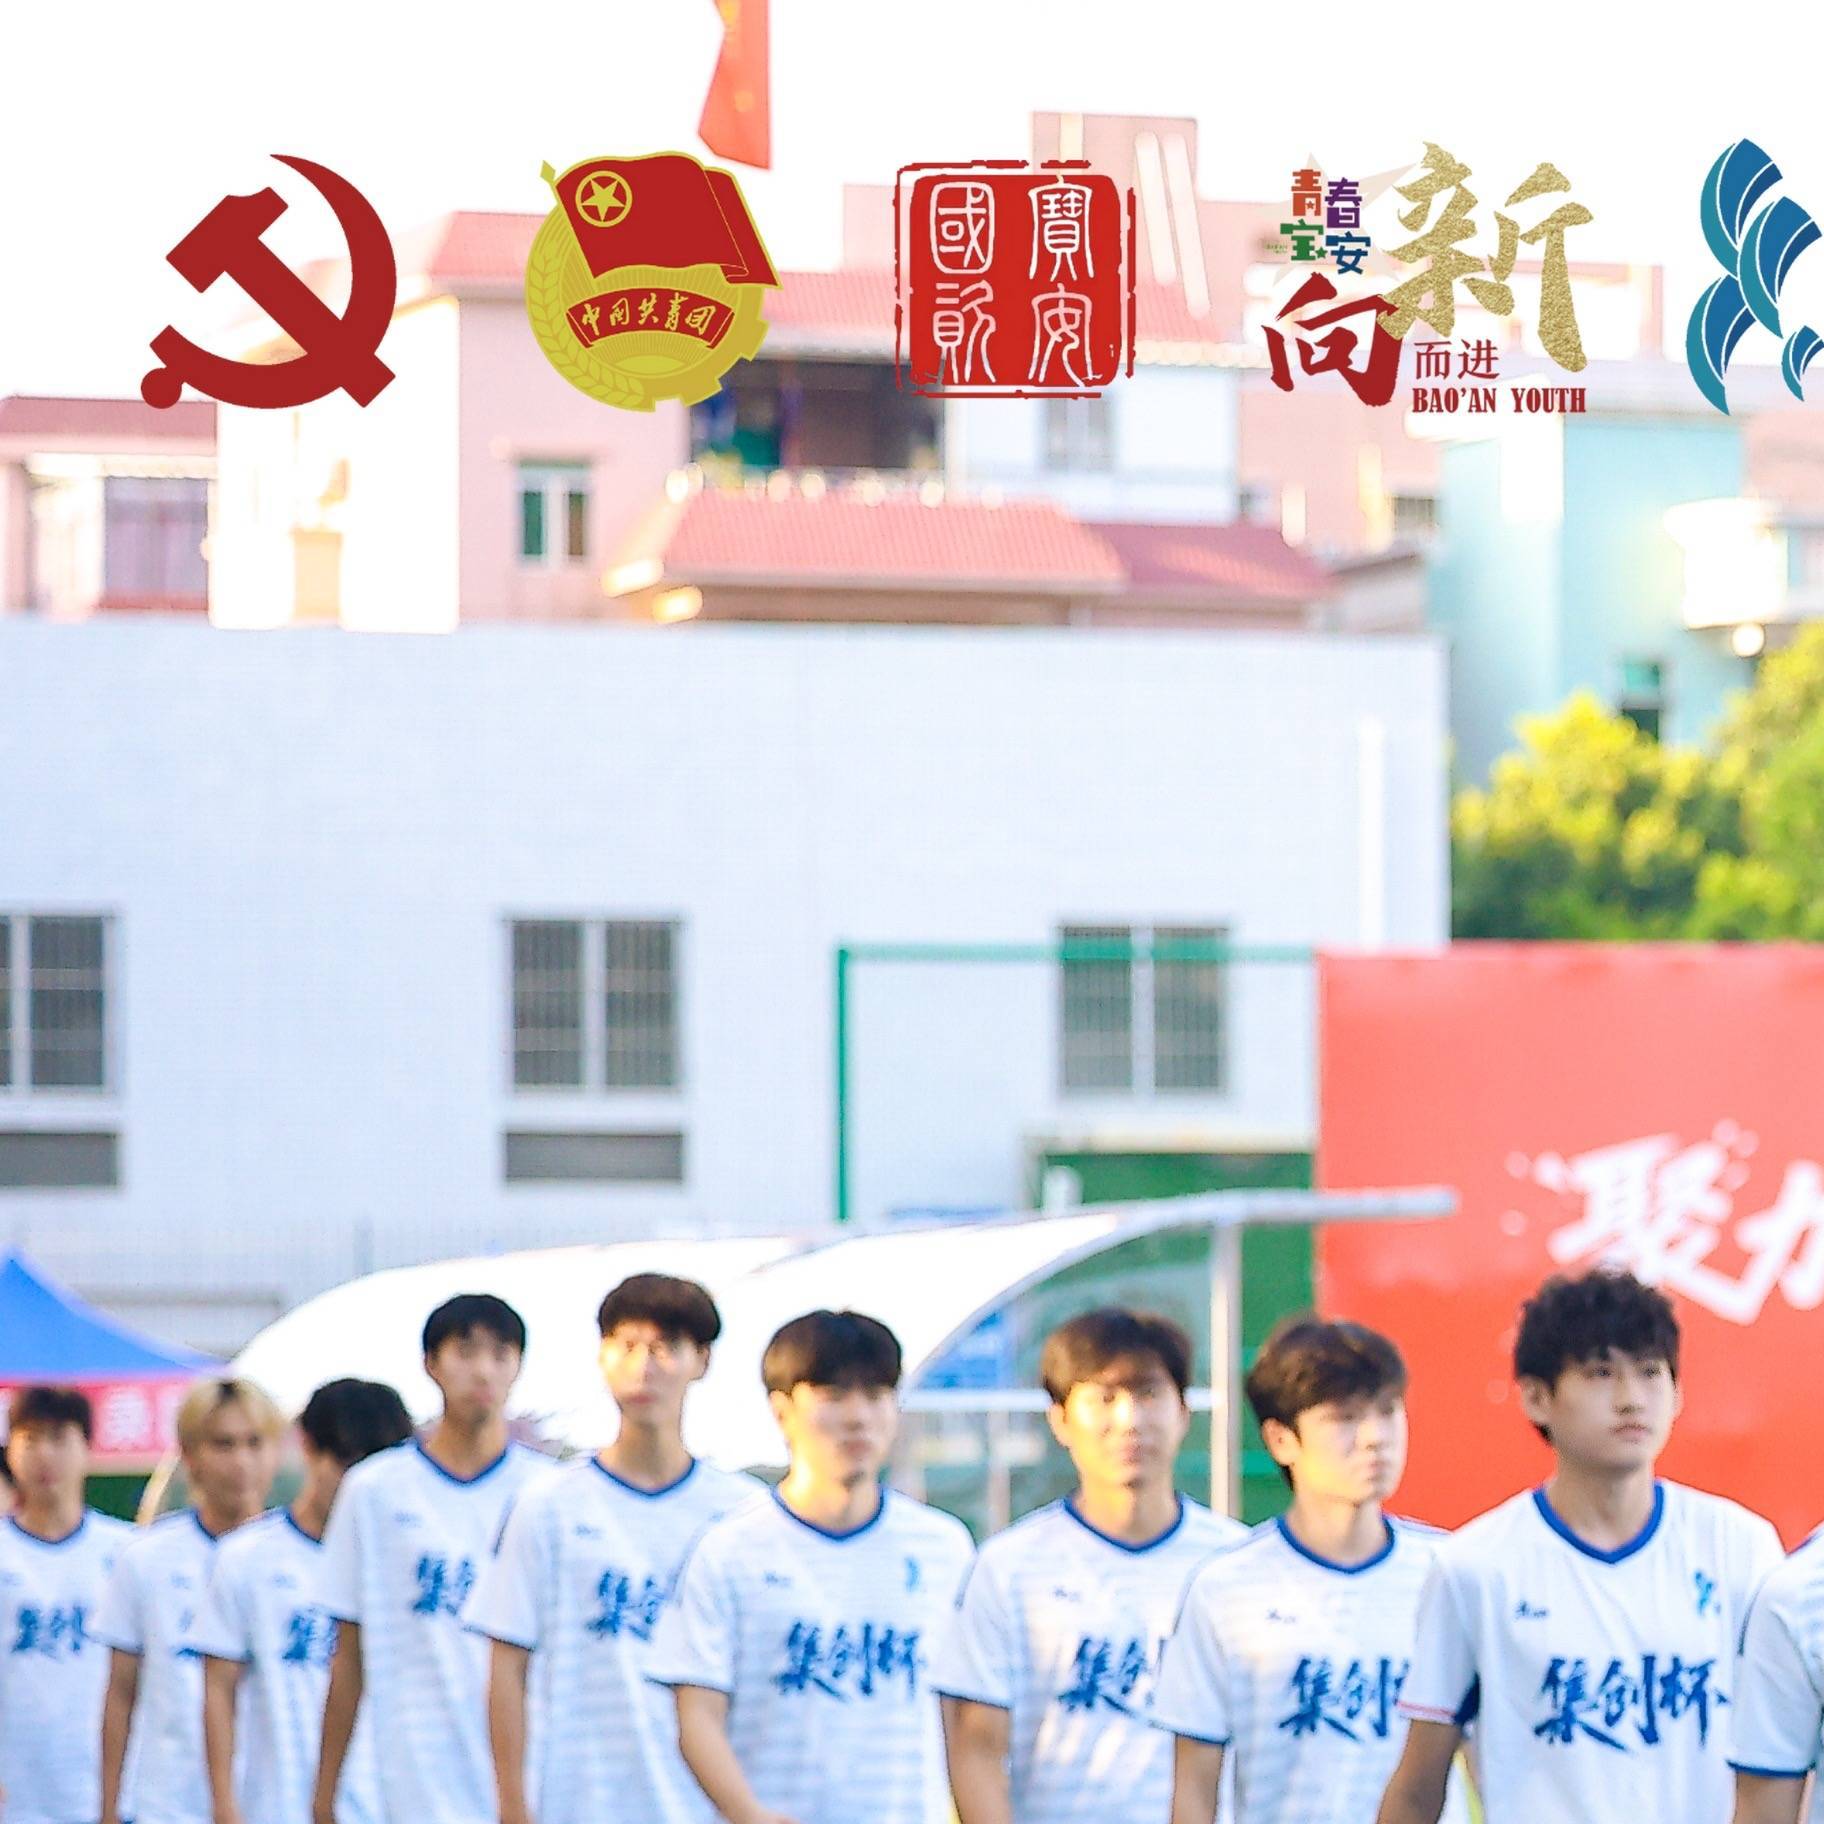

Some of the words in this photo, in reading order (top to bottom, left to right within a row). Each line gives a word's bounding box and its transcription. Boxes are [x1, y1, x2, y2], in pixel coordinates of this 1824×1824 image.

[1278, 1655, 1410, 1743] 集创
[1534, 1654, 1732, 1752] 集创杯
